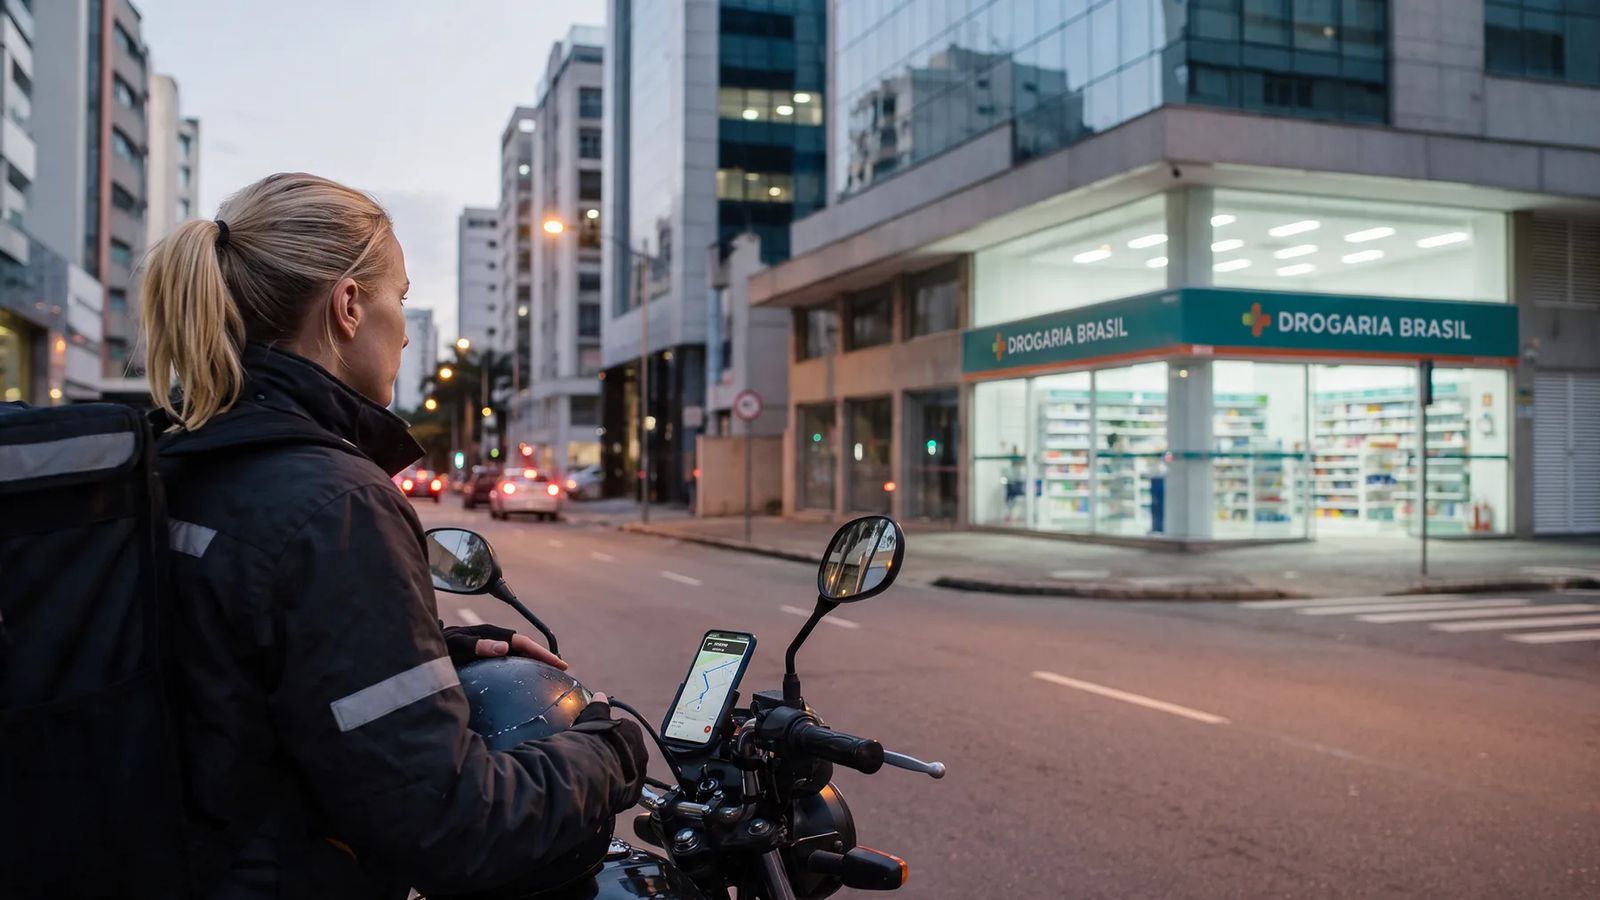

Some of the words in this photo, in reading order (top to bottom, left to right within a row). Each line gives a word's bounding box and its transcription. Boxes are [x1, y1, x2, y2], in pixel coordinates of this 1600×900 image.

[1007, 326, 1074, 354] DROGARIA
[1077, 317, 1128, 343] BRASIL
[1278, 311, 1393, 336] DROGARIA
[1400, 317, 1472, 340] BRASIL
